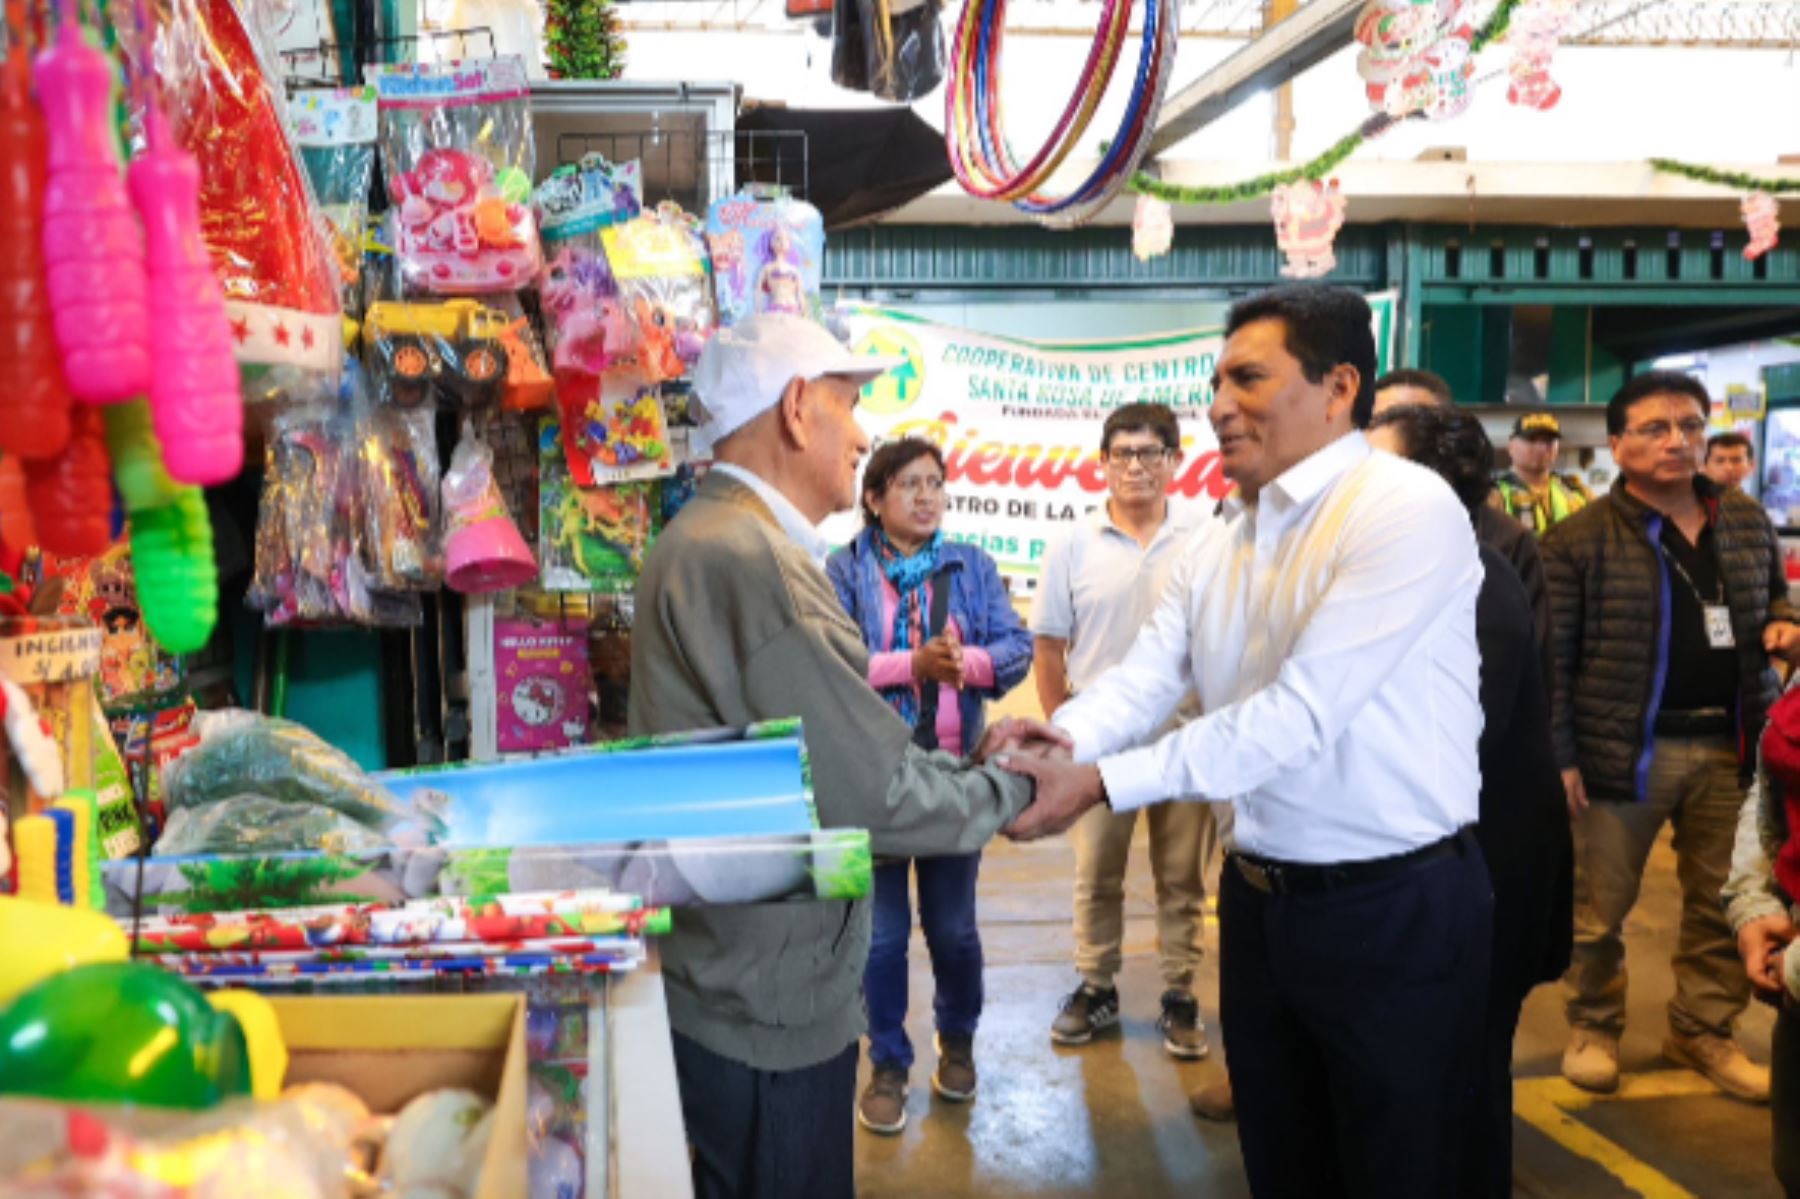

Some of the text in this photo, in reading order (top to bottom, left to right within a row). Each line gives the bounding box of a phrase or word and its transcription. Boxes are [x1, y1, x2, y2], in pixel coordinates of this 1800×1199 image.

[941, 342, 1081, 383] COOPERATIVA
[1087, 363, 1114, 384] DE
[968, 374, 1028, 402] SANTA
[1135, 382, 1213, 407] AMERI
[1007, 498, 1037, 519] DE
[1045, 501, 1076, 521] LA
